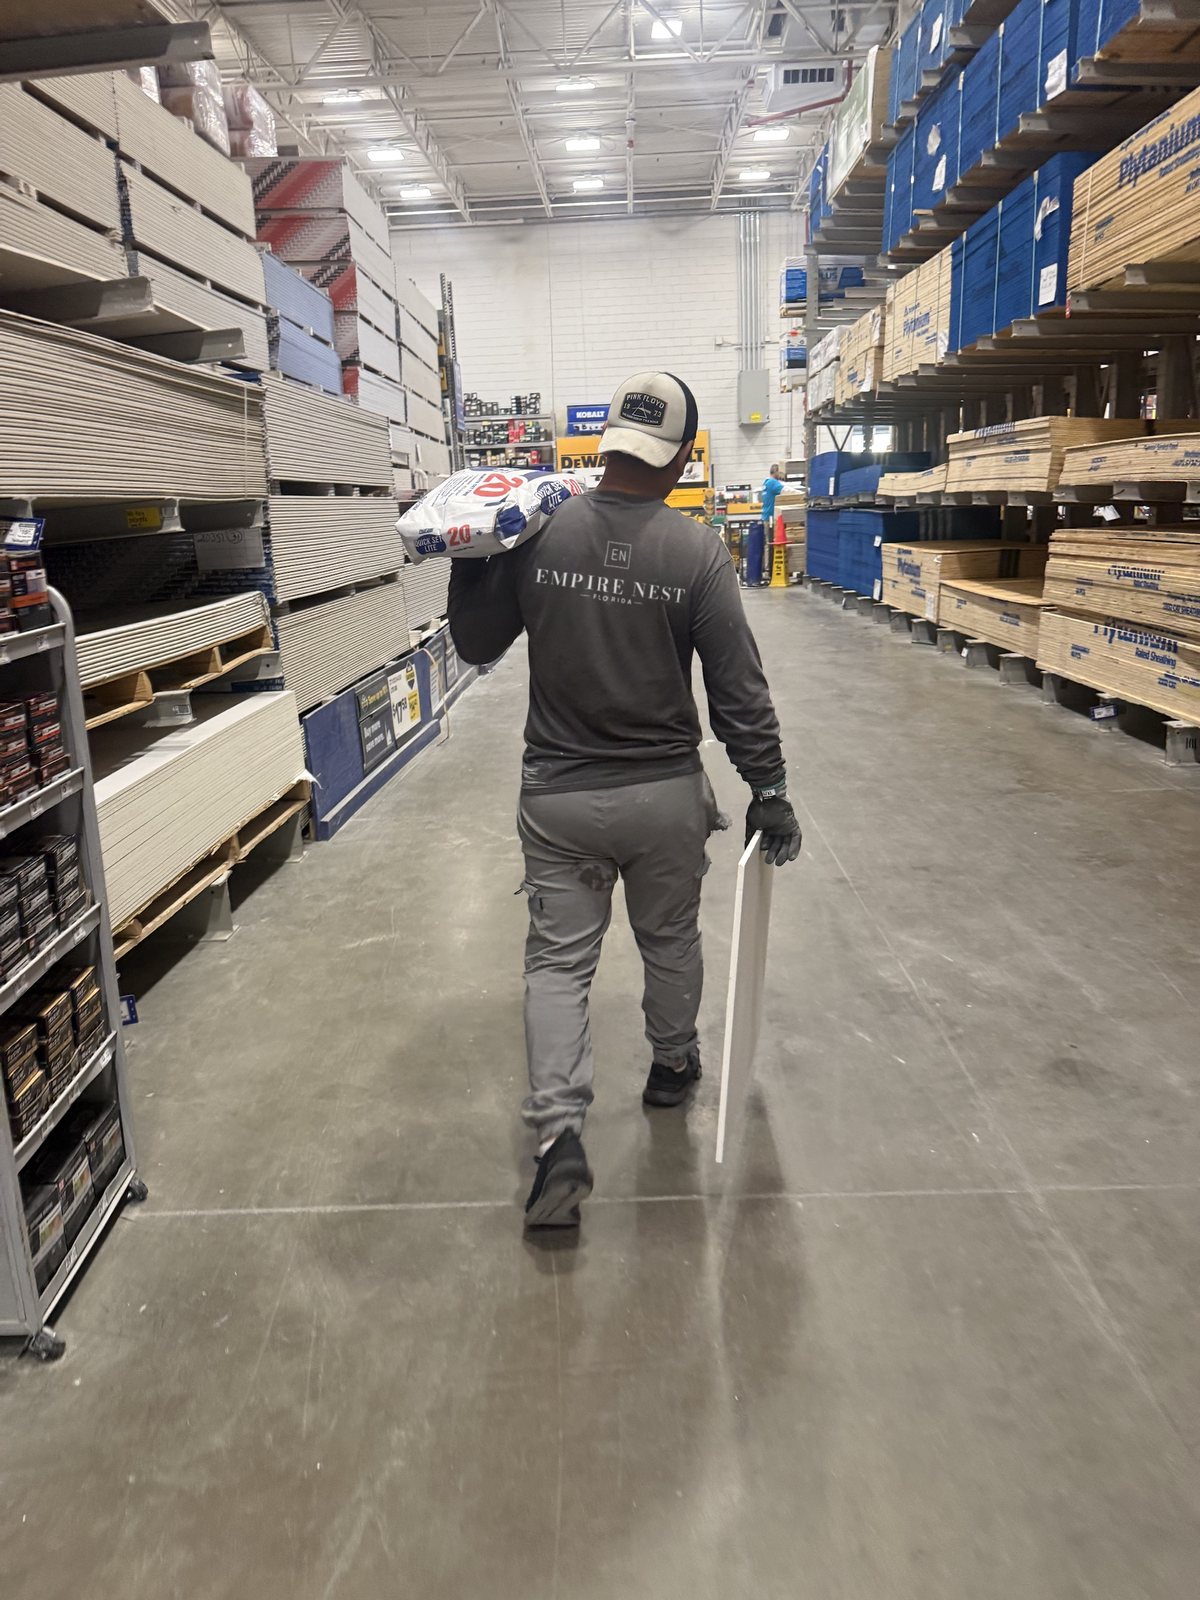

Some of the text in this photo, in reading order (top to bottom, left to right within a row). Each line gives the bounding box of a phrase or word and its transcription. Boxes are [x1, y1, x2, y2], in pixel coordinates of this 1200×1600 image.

[643, 395, 665, 409] FLOYD
[576, 411, 605, 419] KOBALT
[473, 473, 524, 498] 20
[534, 483, 553, 500] QUICK
[547, 492, 563, 508] LITE
[415, 535, 443, 548] QUICK SET
[447, 524, 472, 547] 20
[424, 545, 438, 553] LITE
[610, 548, 627, 562] EN
[535, 568, 686, 604] EMPIRE NEST
[592, 593, 632, 605] FLORIDA
